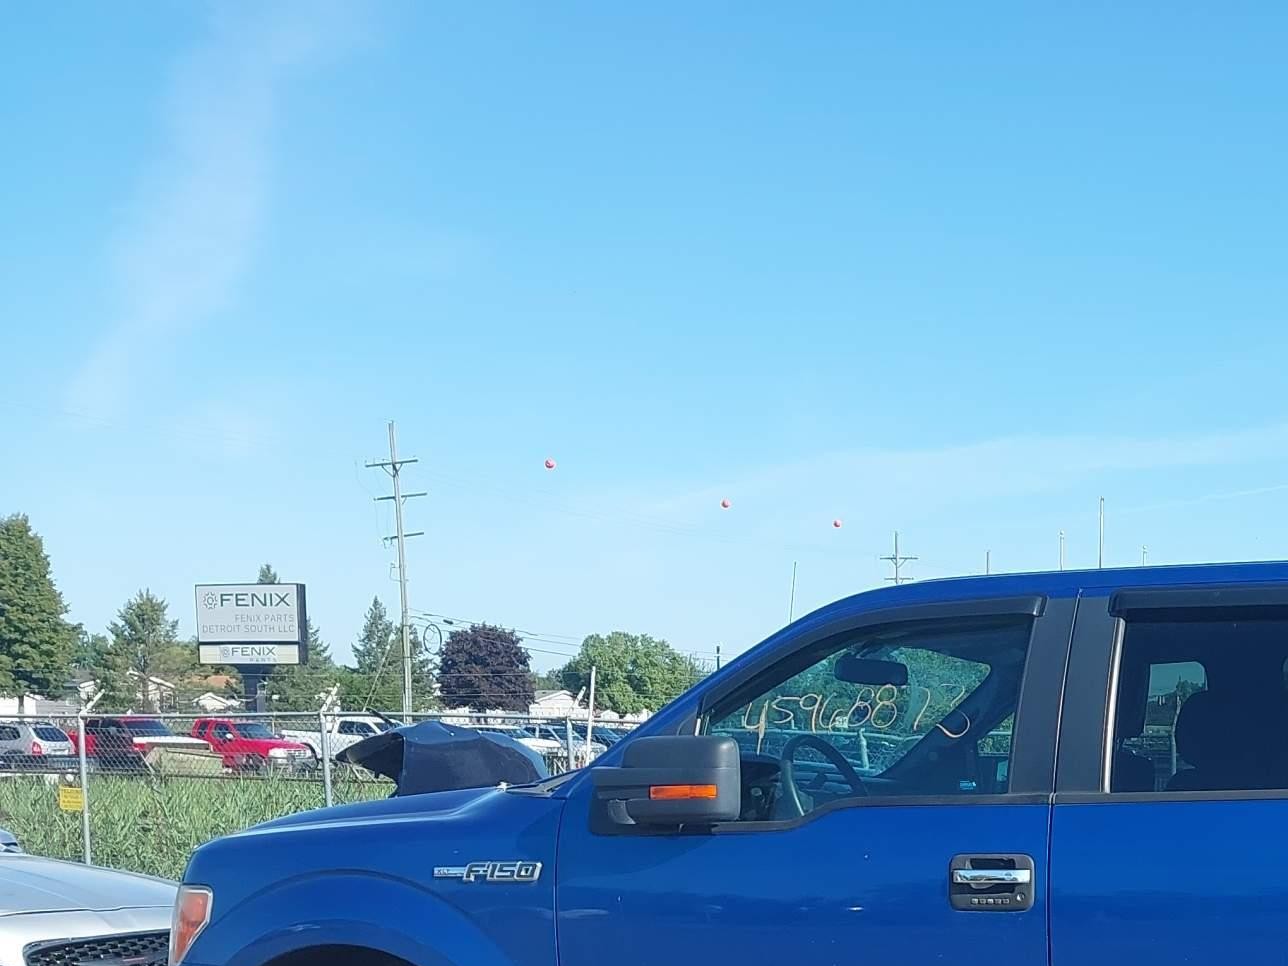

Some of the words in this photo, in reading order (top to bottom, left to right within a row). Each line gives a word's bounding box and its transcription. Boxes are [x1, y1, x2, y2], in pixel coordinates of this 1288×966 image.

[219, 592, 290, 607] FENIX
[234, 613, 262, 623] FENIX
[264, 613, 295, 622] PARTS
[202, 624, 241, 634] DETROIT
[244, 624, 276, 633] SOUTH
[278, 624, 295, 633] LLC
[231, 646, 276, 657] FENIX
